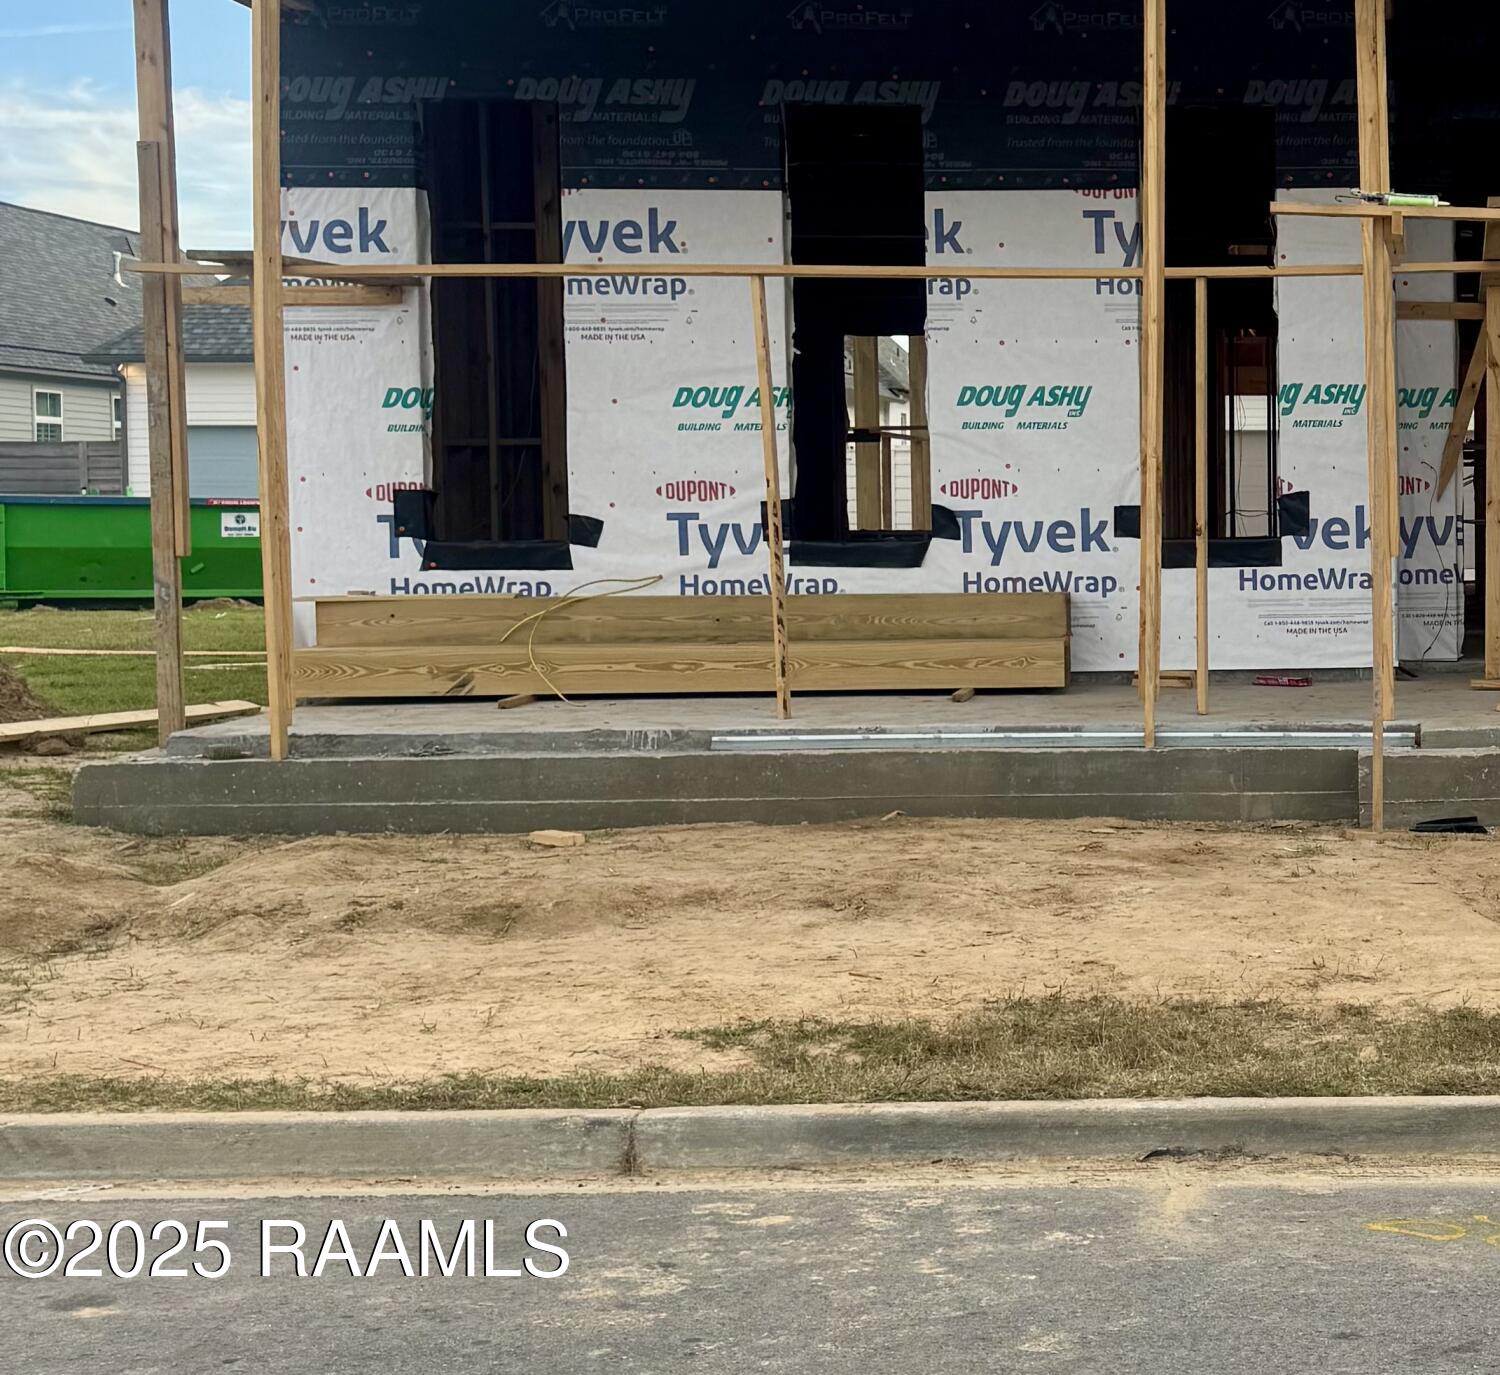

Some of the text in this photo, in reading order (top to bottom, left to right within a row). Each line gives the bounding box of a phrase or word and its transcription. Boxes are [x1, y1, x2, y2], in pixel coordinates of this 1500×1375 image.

[563, 207, 682, 262] yvek
[567, 275, 687, 301] meWrap
[957, 383, 1092, 417] DOUG ASHY
[1399, 387, 1440, 418] OUG
[387, 424, 425, 433] BUILDIN
[677, 423, 722, 432] BUILDING
[961, 421, 1069, 430] BUILDING MATERIALS
[1292, 419, 1344, 428] MATERIALS
[665, 481, 727, 502] DUPONT
[950, 478, 1011, 501] DUPONT
[957, 507, 1112, 566] Tyvek
[1293, 505, 1372, 551] vek
[963, 569, 1118, 598] HomeWrap
[1239, 567, 1373, 593] HomeWra
